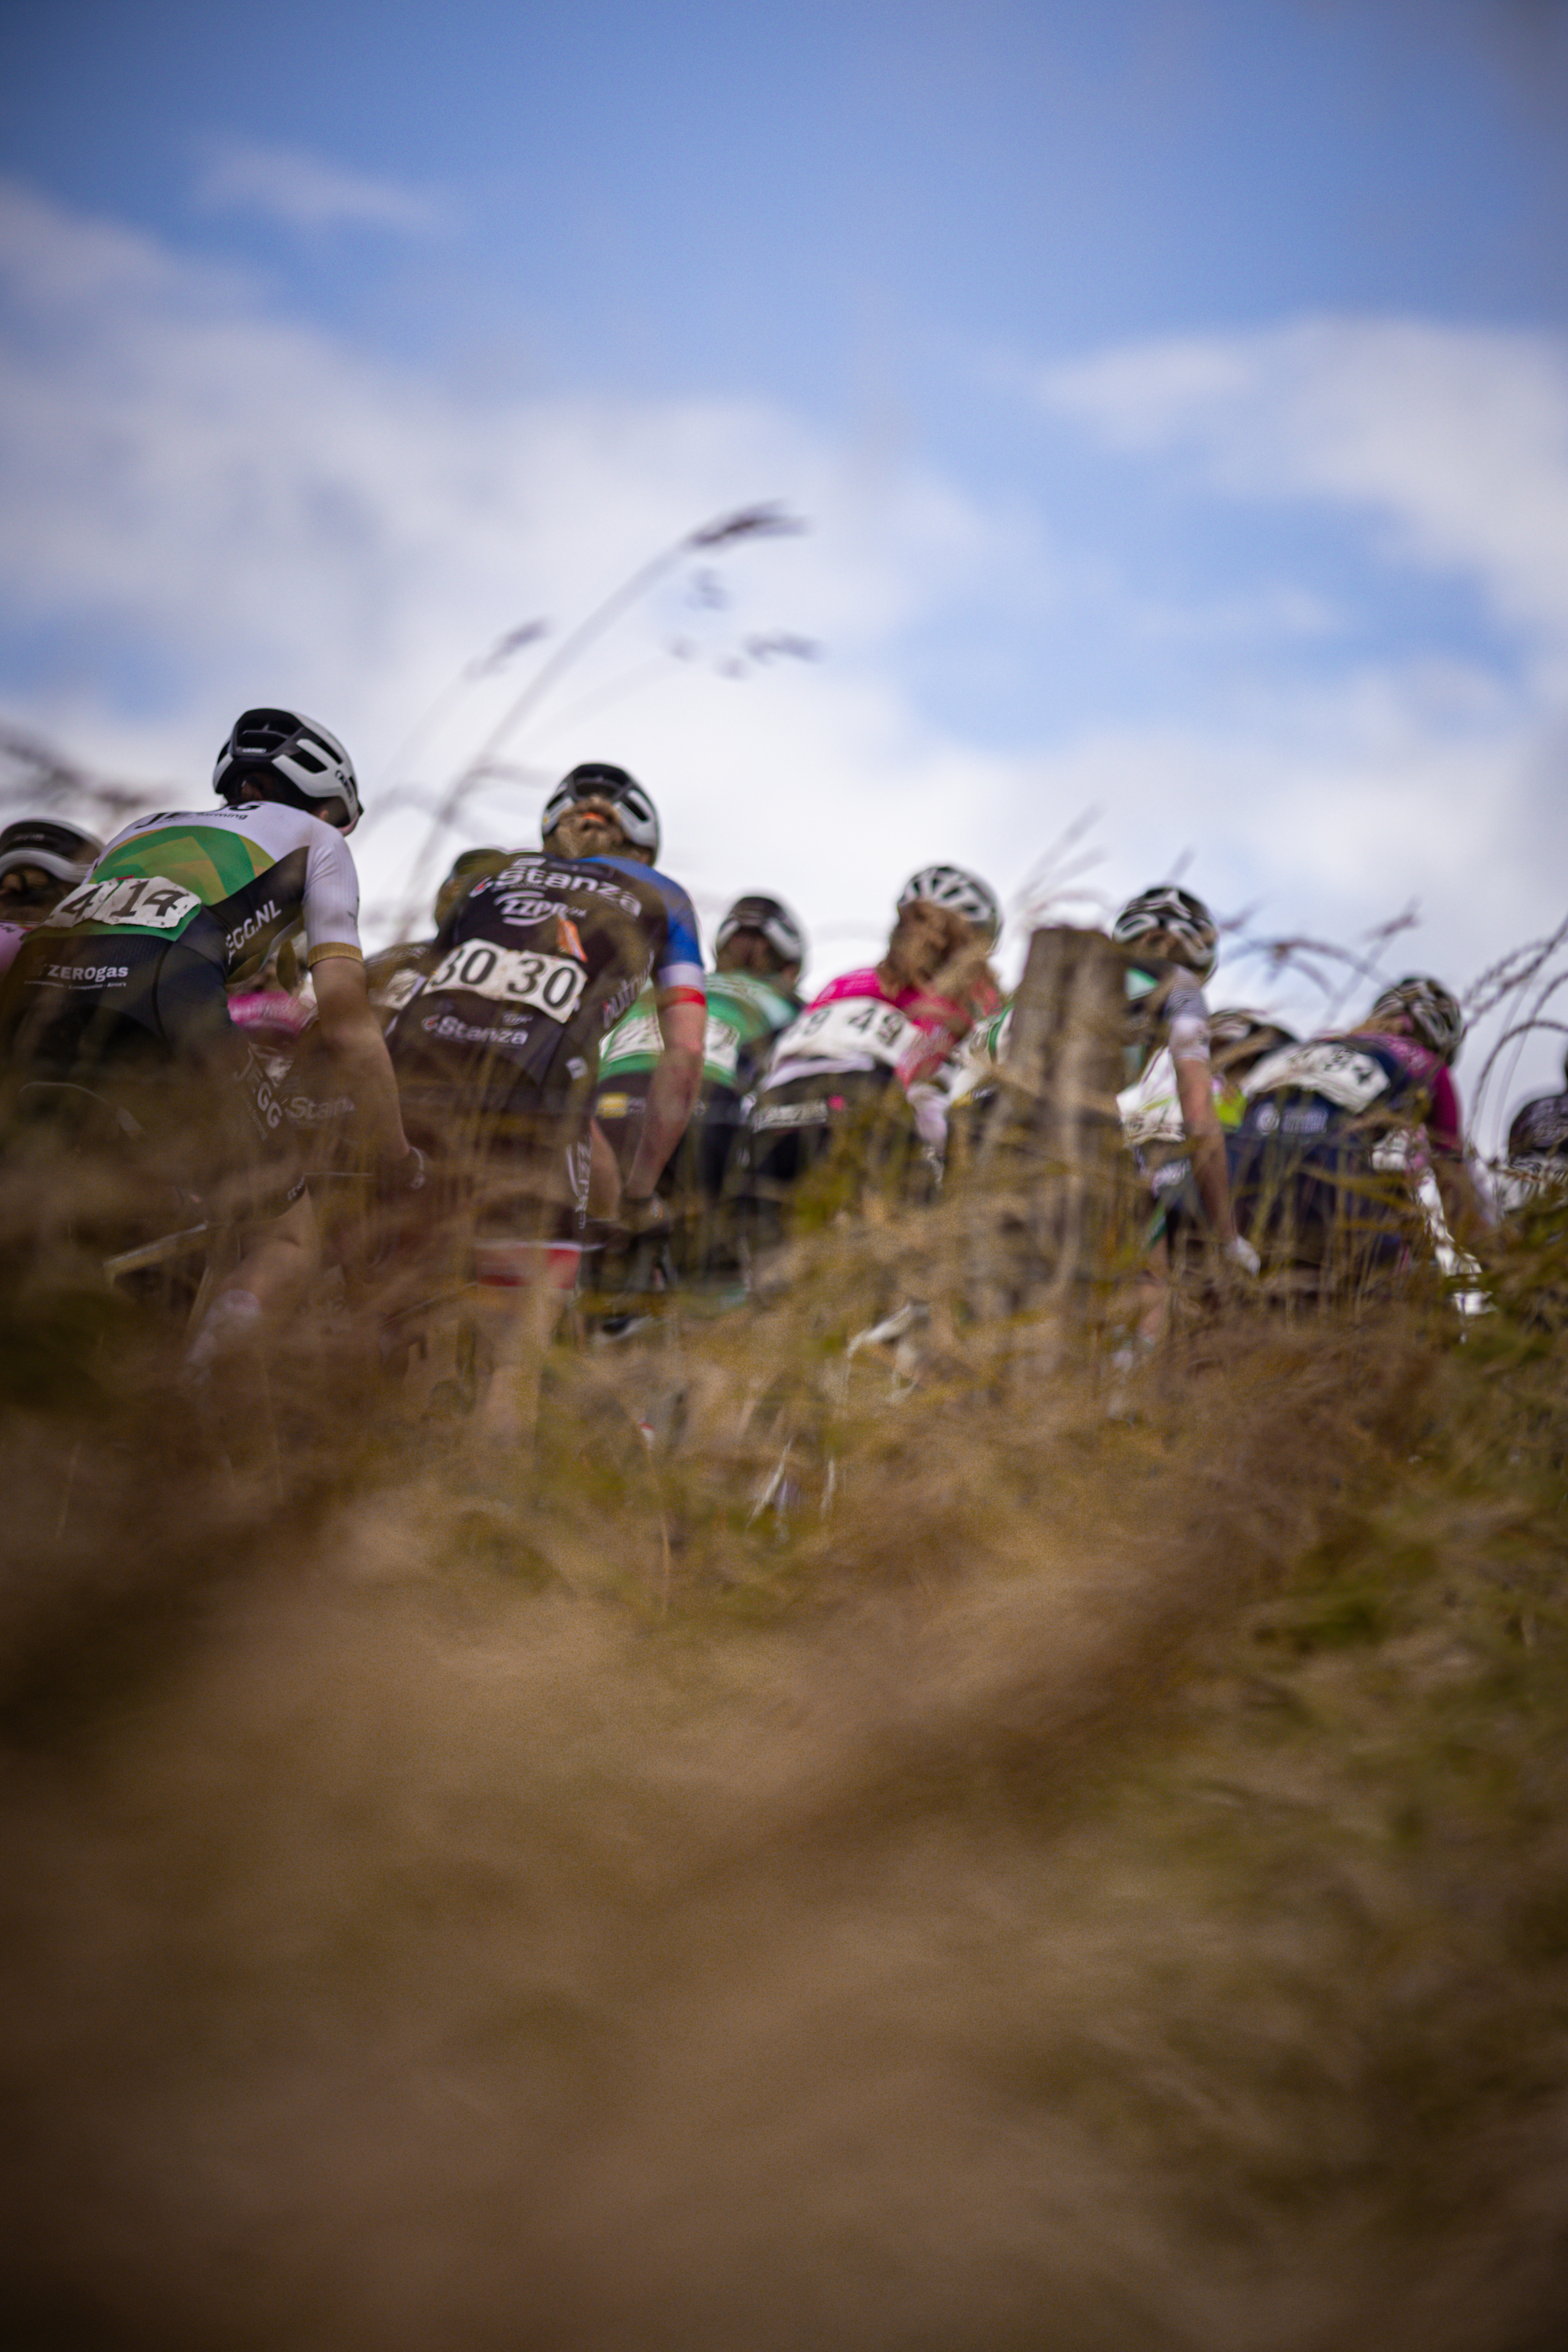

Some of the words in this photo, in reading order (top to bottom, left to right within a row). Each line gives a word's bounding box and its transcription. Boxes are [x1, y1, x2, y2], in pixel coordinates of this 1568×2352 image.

[110, 880, 185, 917] 14
[493, 866, 642, 918] Stanza
[47, 964, 129, 982] ZEROgas
[507, 959, 577, 1008] 30
[436, 1016, 529, 1046] Stanza
